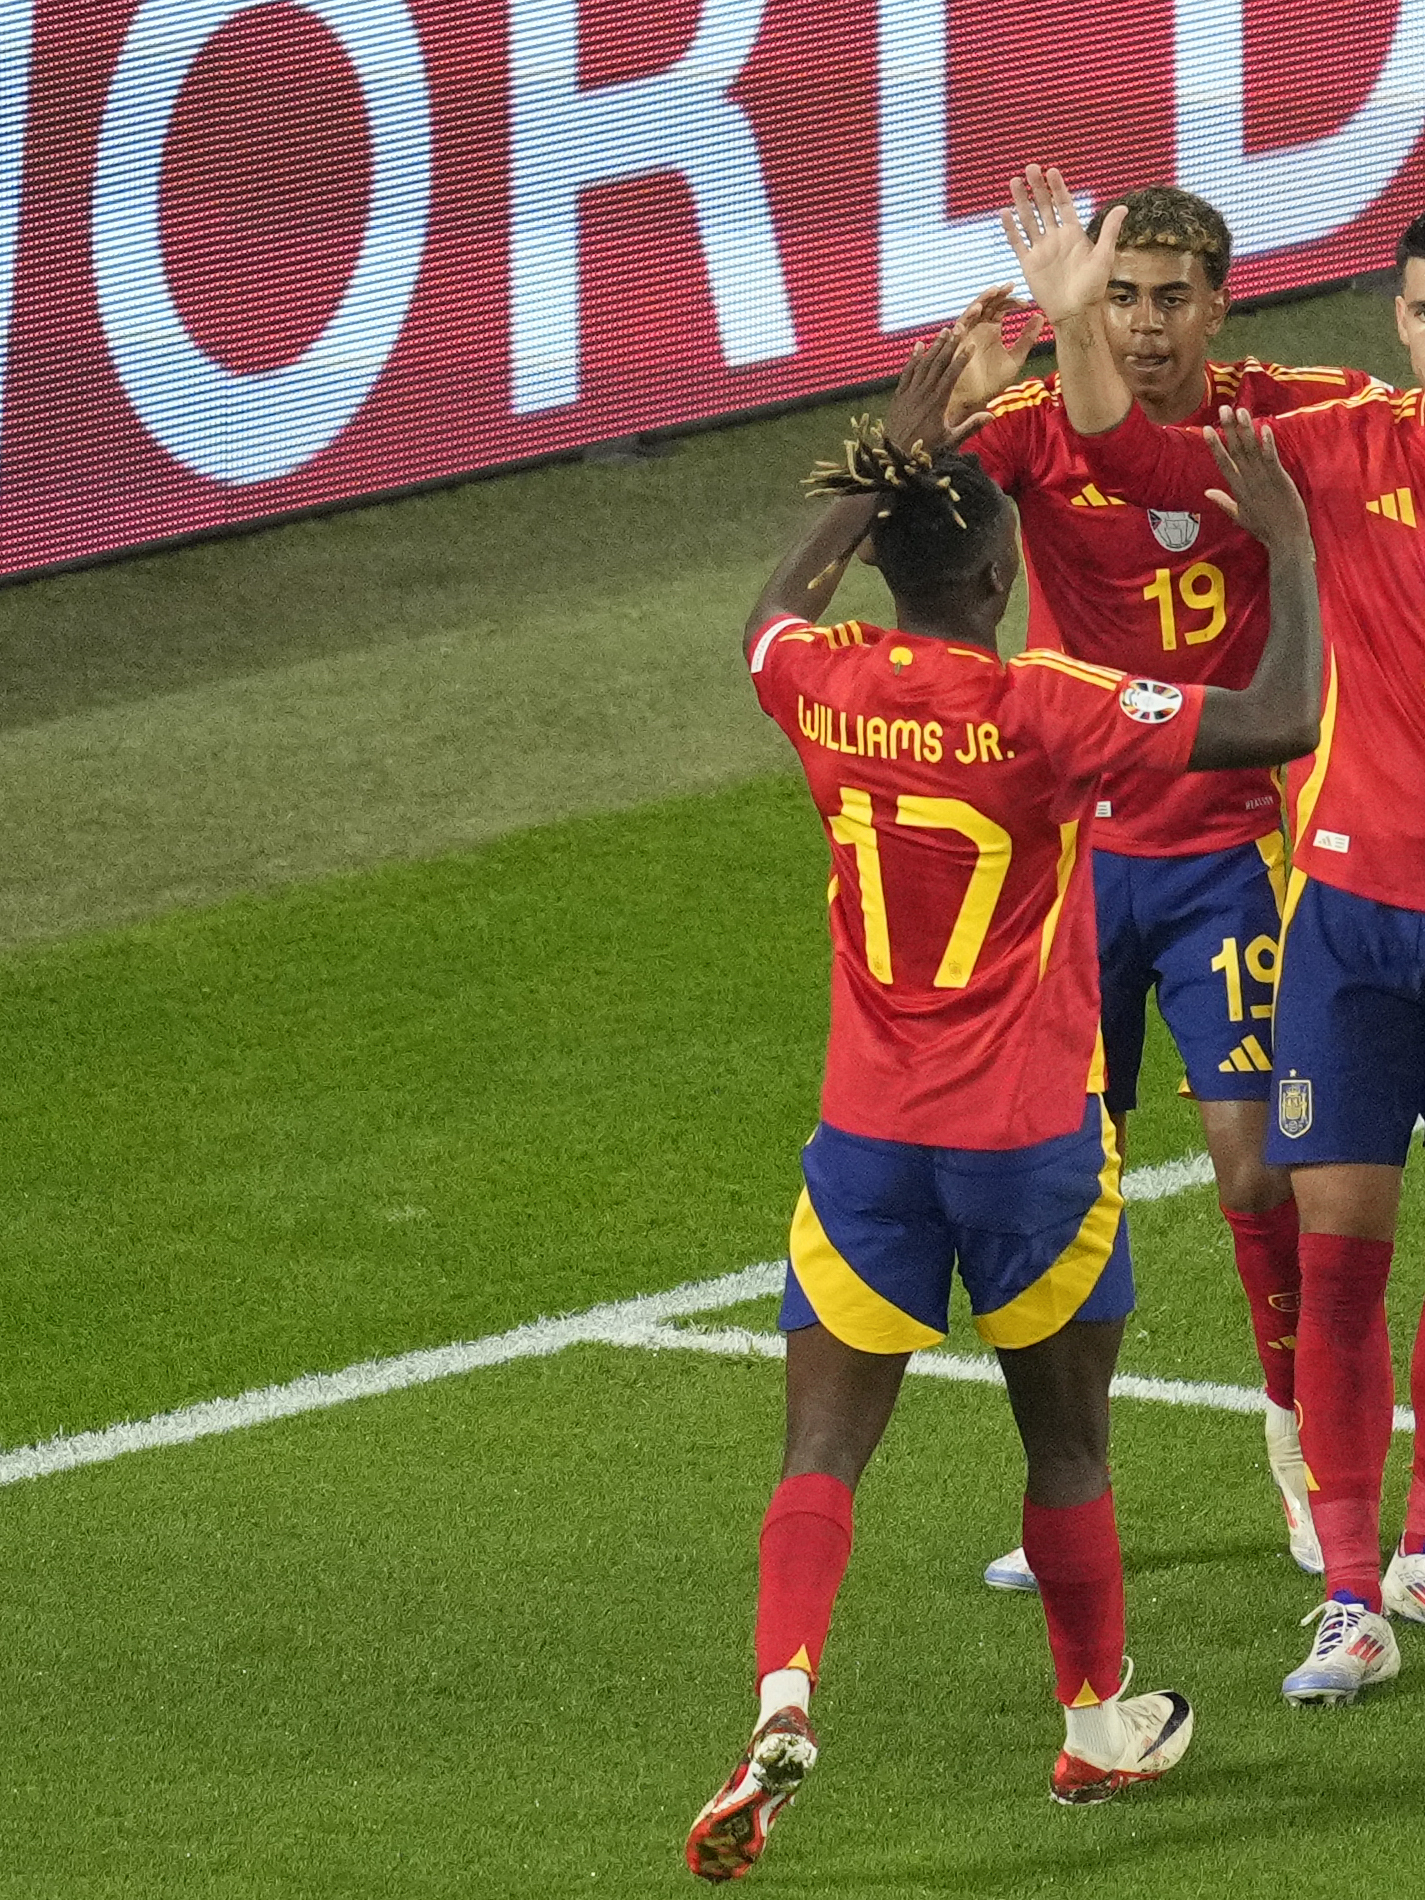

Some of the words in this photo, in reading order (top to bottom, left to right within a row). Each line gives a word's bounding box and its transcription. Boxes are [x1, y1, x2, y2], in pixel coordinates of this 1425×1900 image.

[1143, 562, 1227, 651] 19
[797, 695, 943, 764] WILLIAMS
[954, 723, 1017, 764] JR.
[828, 786, 1013, 989] 17
